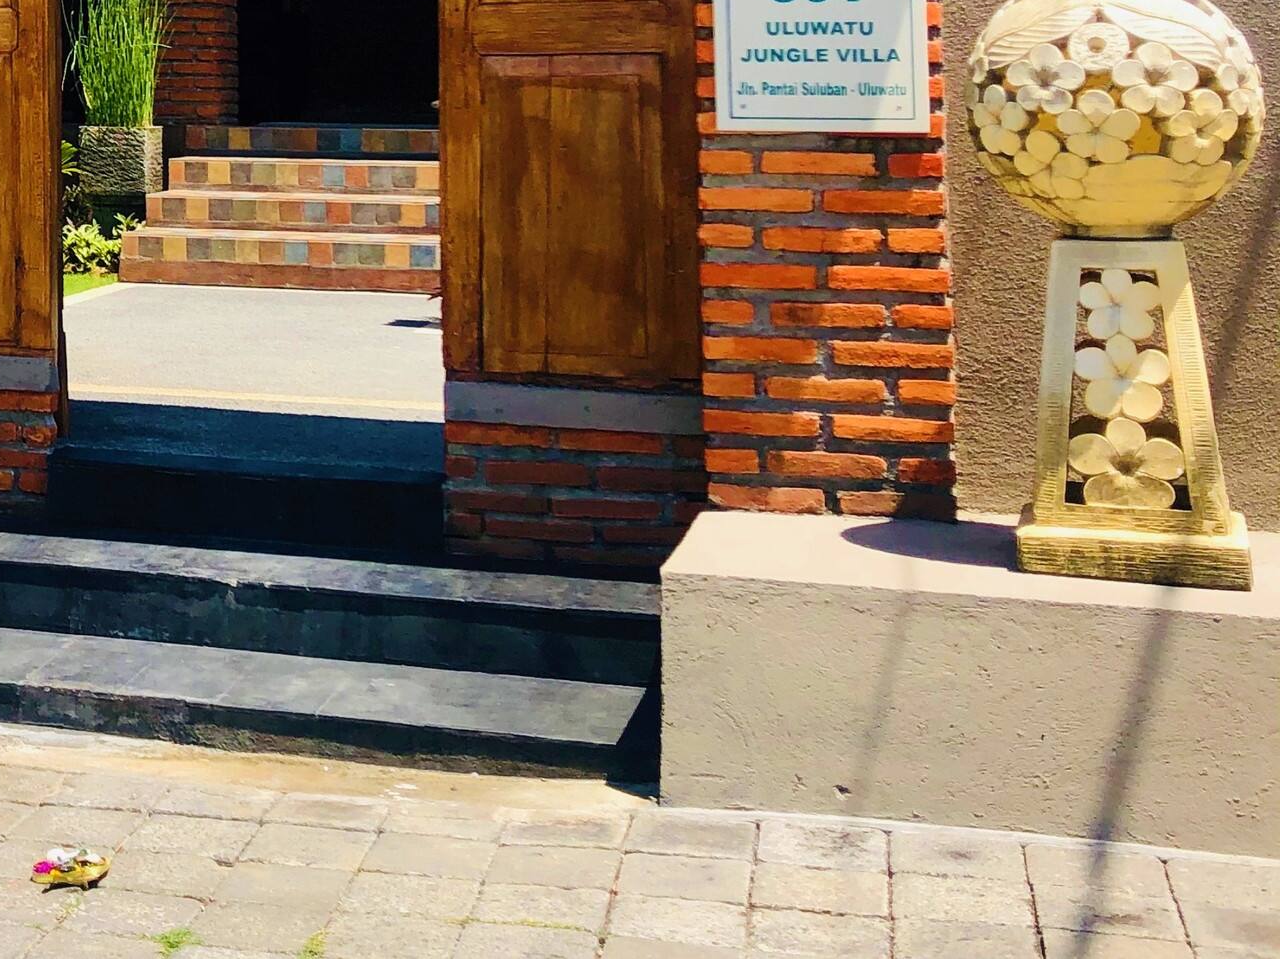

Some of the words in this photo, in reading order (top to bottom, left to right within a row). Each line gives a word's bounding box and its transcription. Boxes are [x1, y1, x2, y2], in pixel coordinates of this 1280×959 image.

[766, 21, 874, 36] ULUWATU
[740, 48, 829, 63] JUNGLE
[837, 48, 900, 62] VILLA
[762, 81, 798, 96] Pantai
[802, 81, 848, 96] Suluban
[858, 82, 907, 96] Uluwatu
